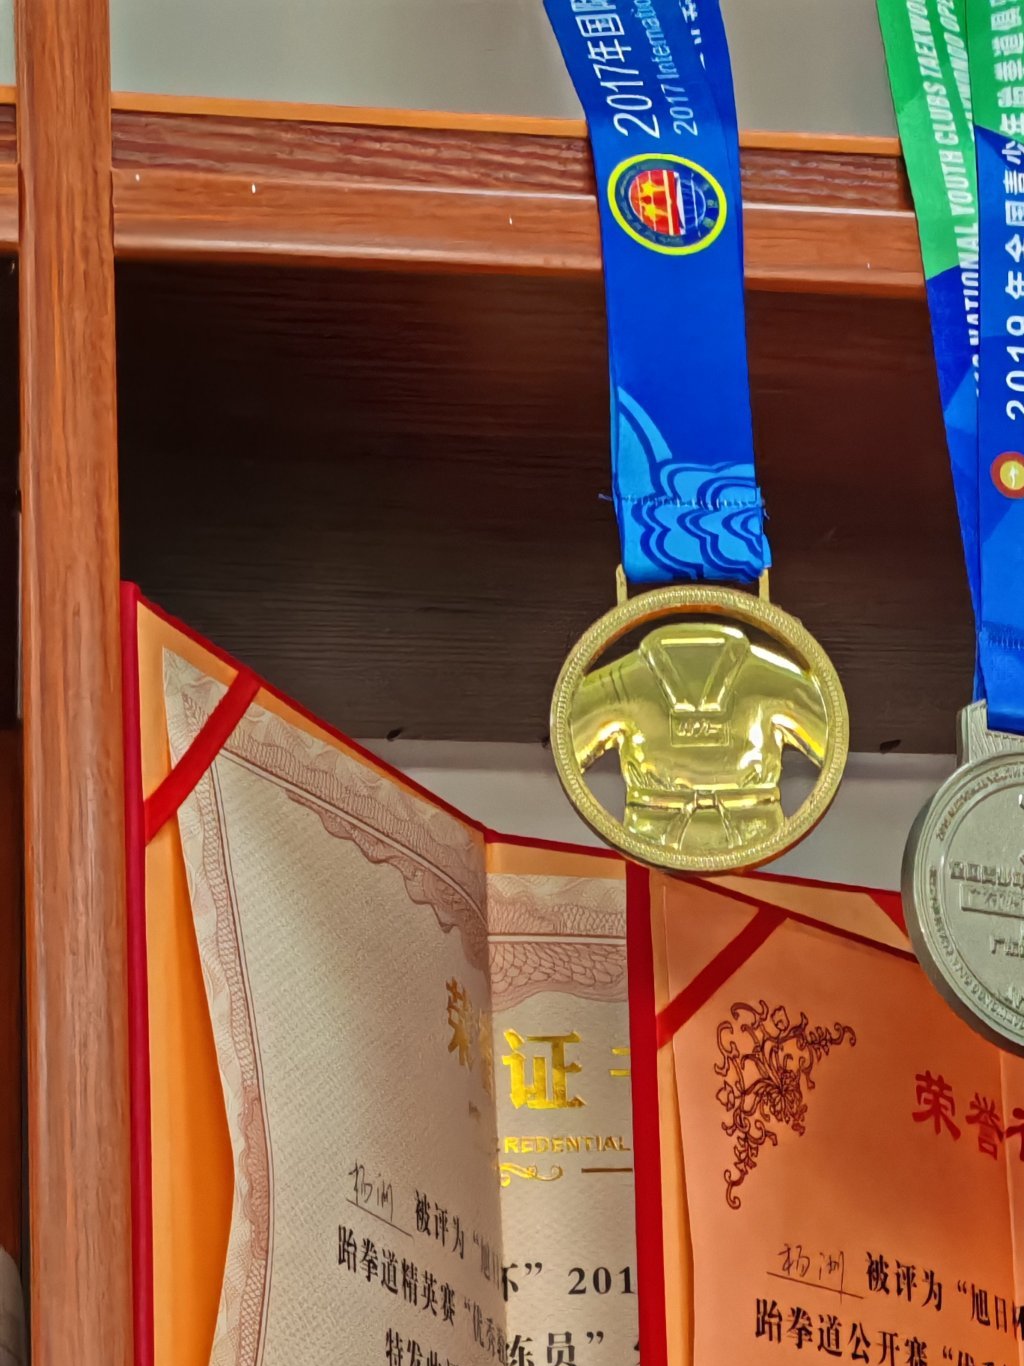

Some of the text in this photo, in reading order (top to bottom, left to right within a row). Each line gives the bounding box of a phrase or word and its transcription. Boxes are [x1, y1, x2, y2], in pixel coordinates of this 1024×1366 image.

[661, 77, 698, 136] 2017
[923, 84, 962, 146] CLUBS
[938, 147, 977, 217] YOUTH
[497, 1135, 631, 1154] REDENTIAL
